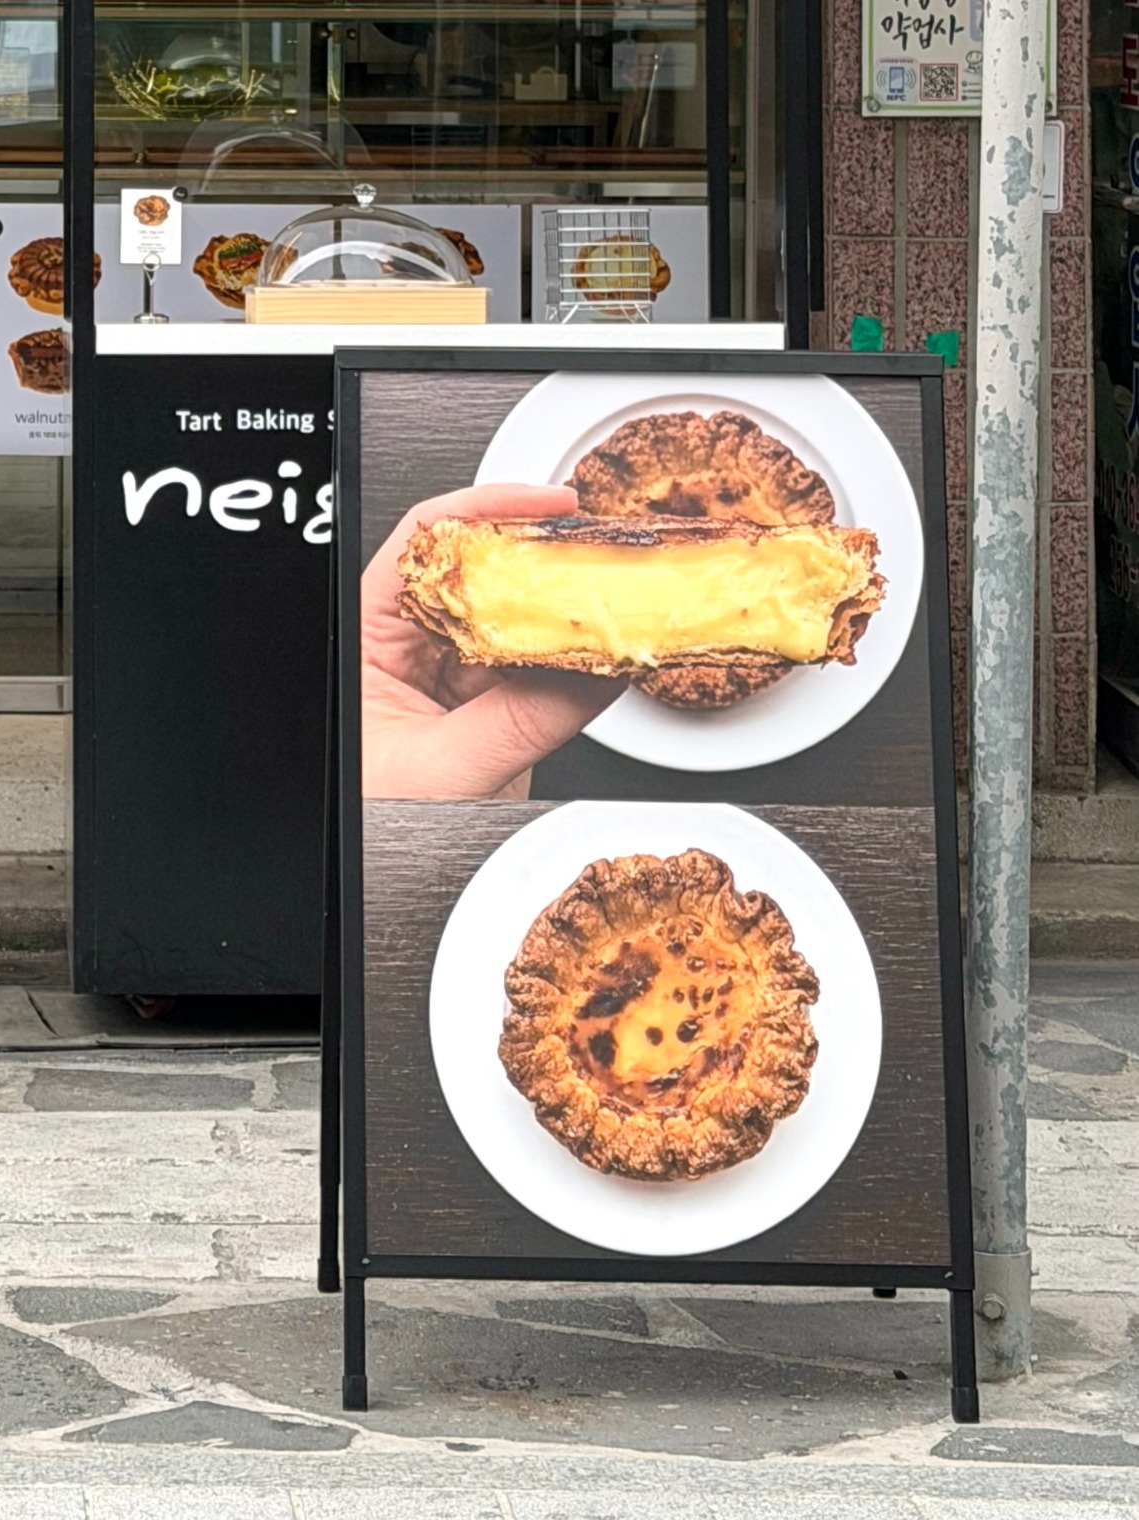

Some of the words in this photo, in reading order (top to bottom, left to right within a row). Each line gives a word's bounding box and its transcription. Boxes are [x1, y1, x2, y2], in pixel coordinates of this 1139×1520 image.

[881, 11, 965, 52] 약업사
[176, 410, 222, 432] Tart
[236, 408, 315, 434] Baking
[123, 460, 333, 544] neig
